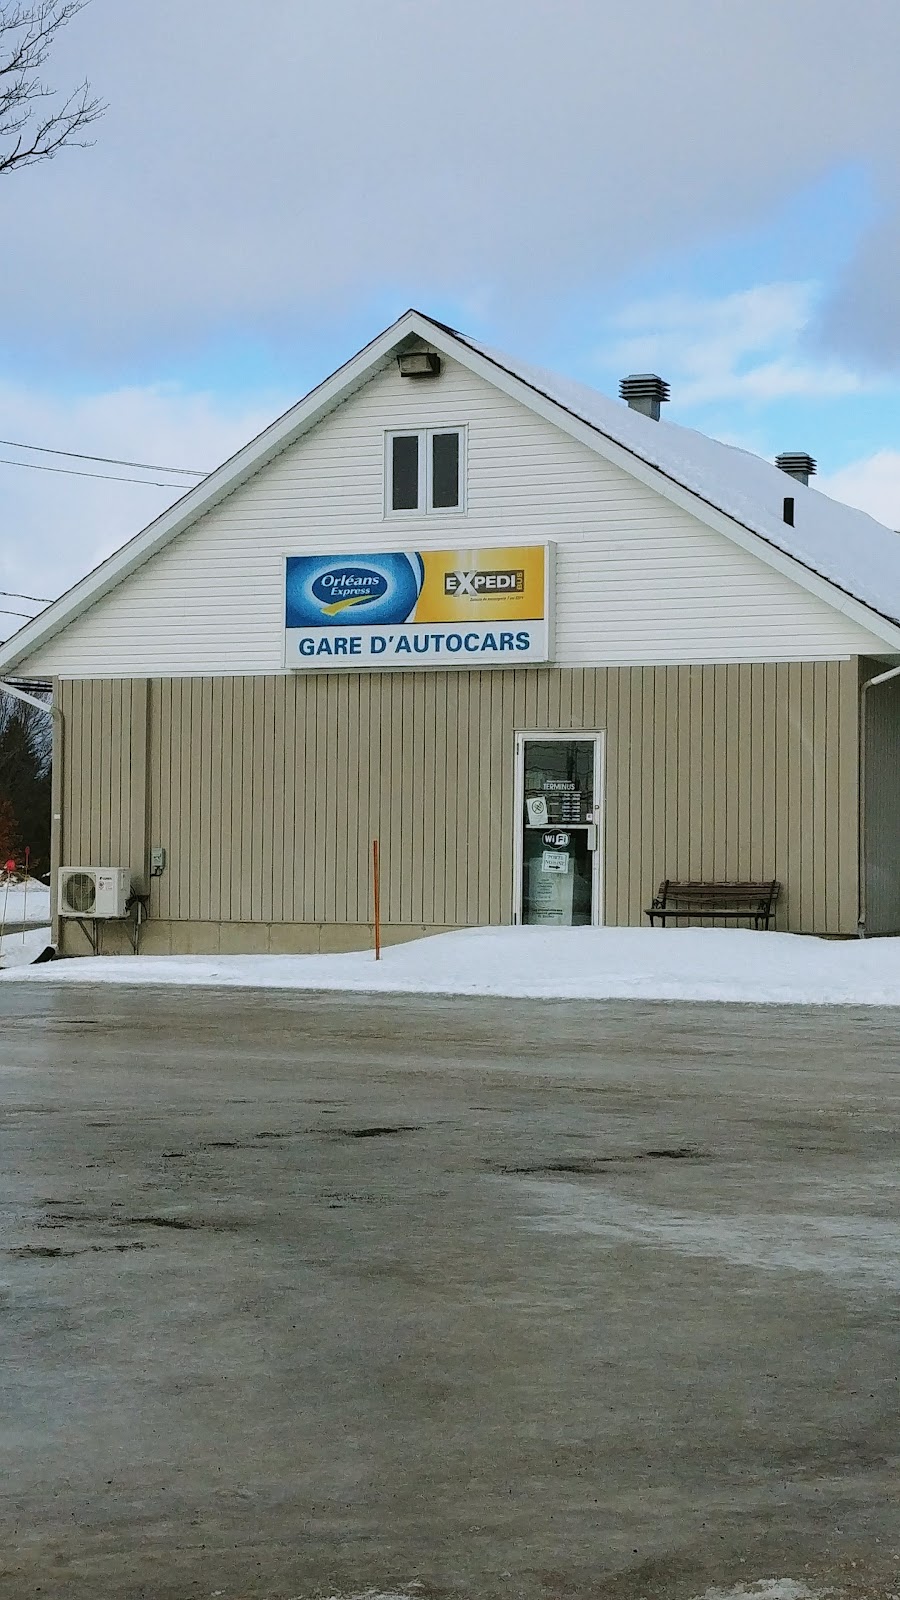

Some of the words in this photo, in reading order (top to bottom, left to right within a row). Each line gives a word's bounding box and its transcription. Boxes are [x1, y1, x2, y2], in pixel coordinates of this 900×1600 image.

[320, 573, 380, 588] Orléans
[330, 586, 371, 597] Express
[298, 636, 362, 656] GARE
[370, 632, 531, 655] D'AUTOCARS
[542, 783, 576, 791] TERMINUS
